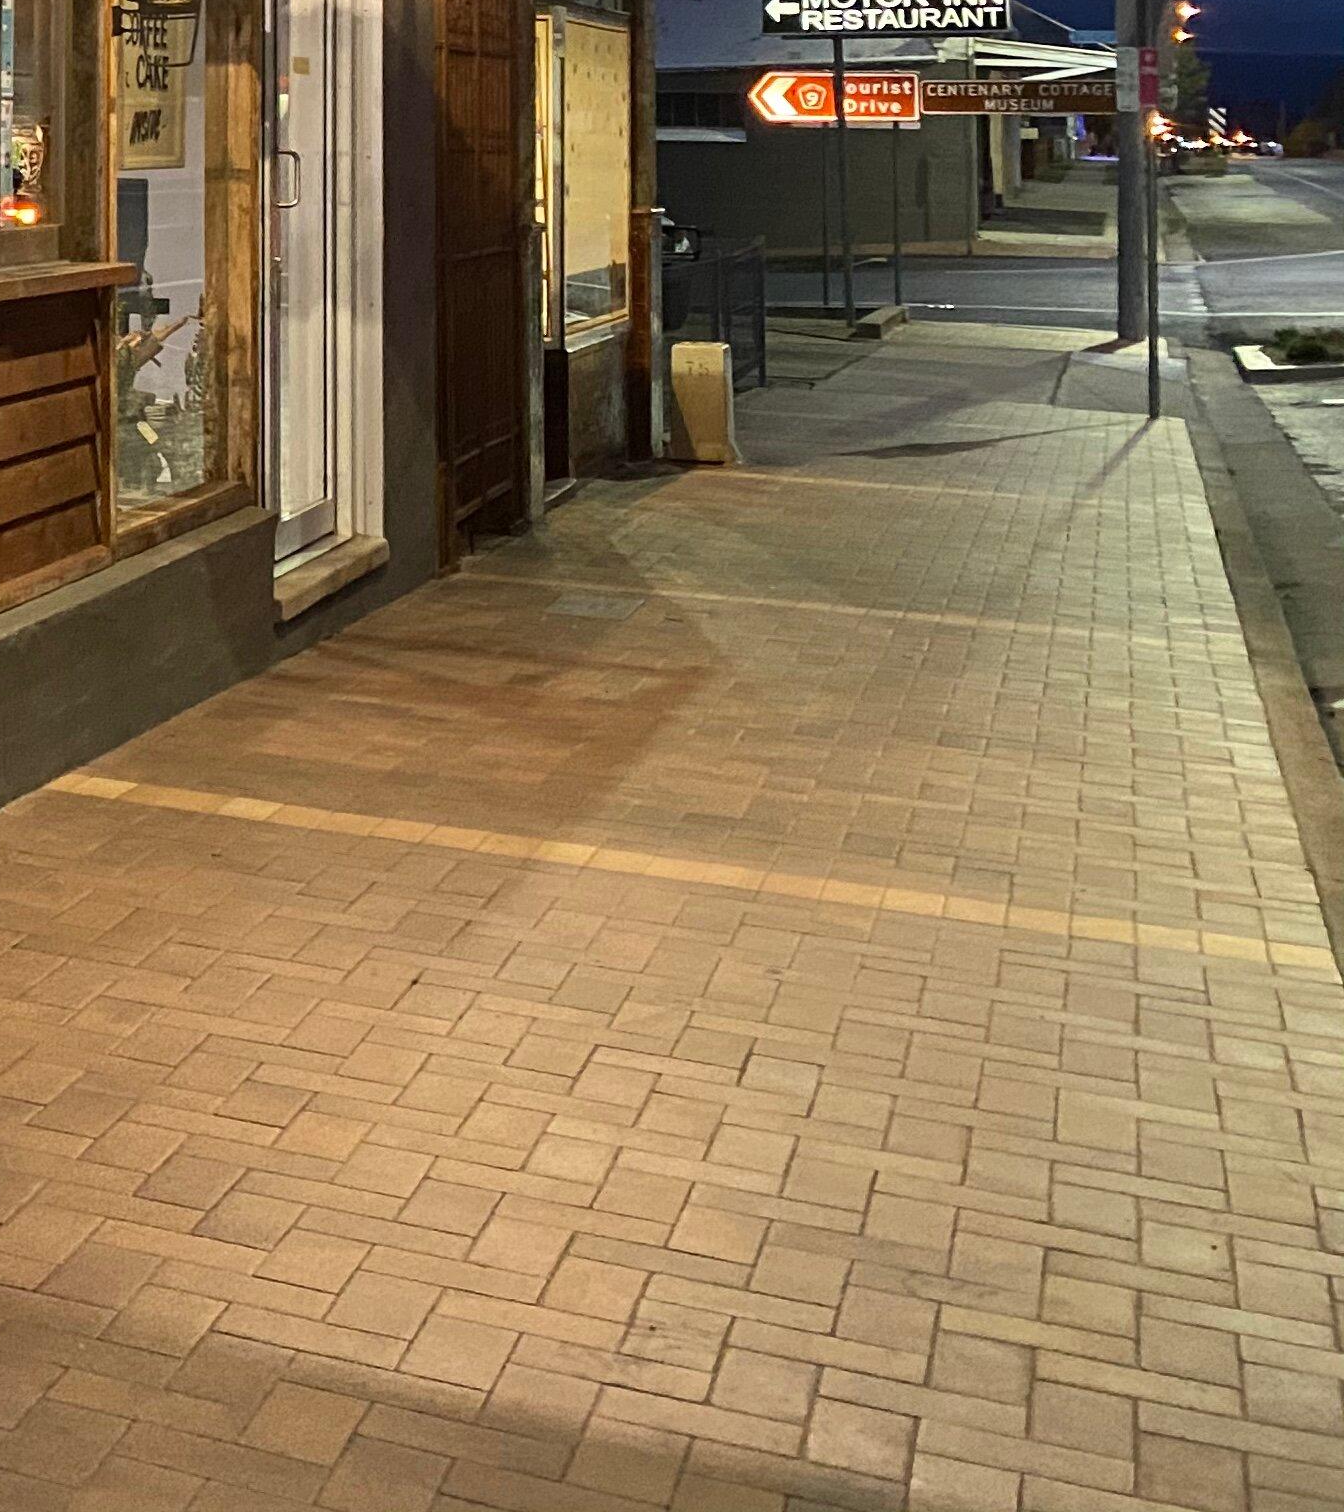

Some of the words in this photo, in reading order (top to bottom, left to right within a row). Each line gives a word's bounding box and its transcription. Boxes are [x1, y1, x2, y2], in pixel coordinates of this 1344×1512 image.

[801, 7, 1004, 31] RESTAURANT
[843, 81, 913, 95] ourist
[926, 84, 1025, 97] CENTENARY
[1038, 84, 1114, 97] COTTAGE
[844, 99, 903, 114] Drive
[984, 99, 1054, 111] MUSEUM
